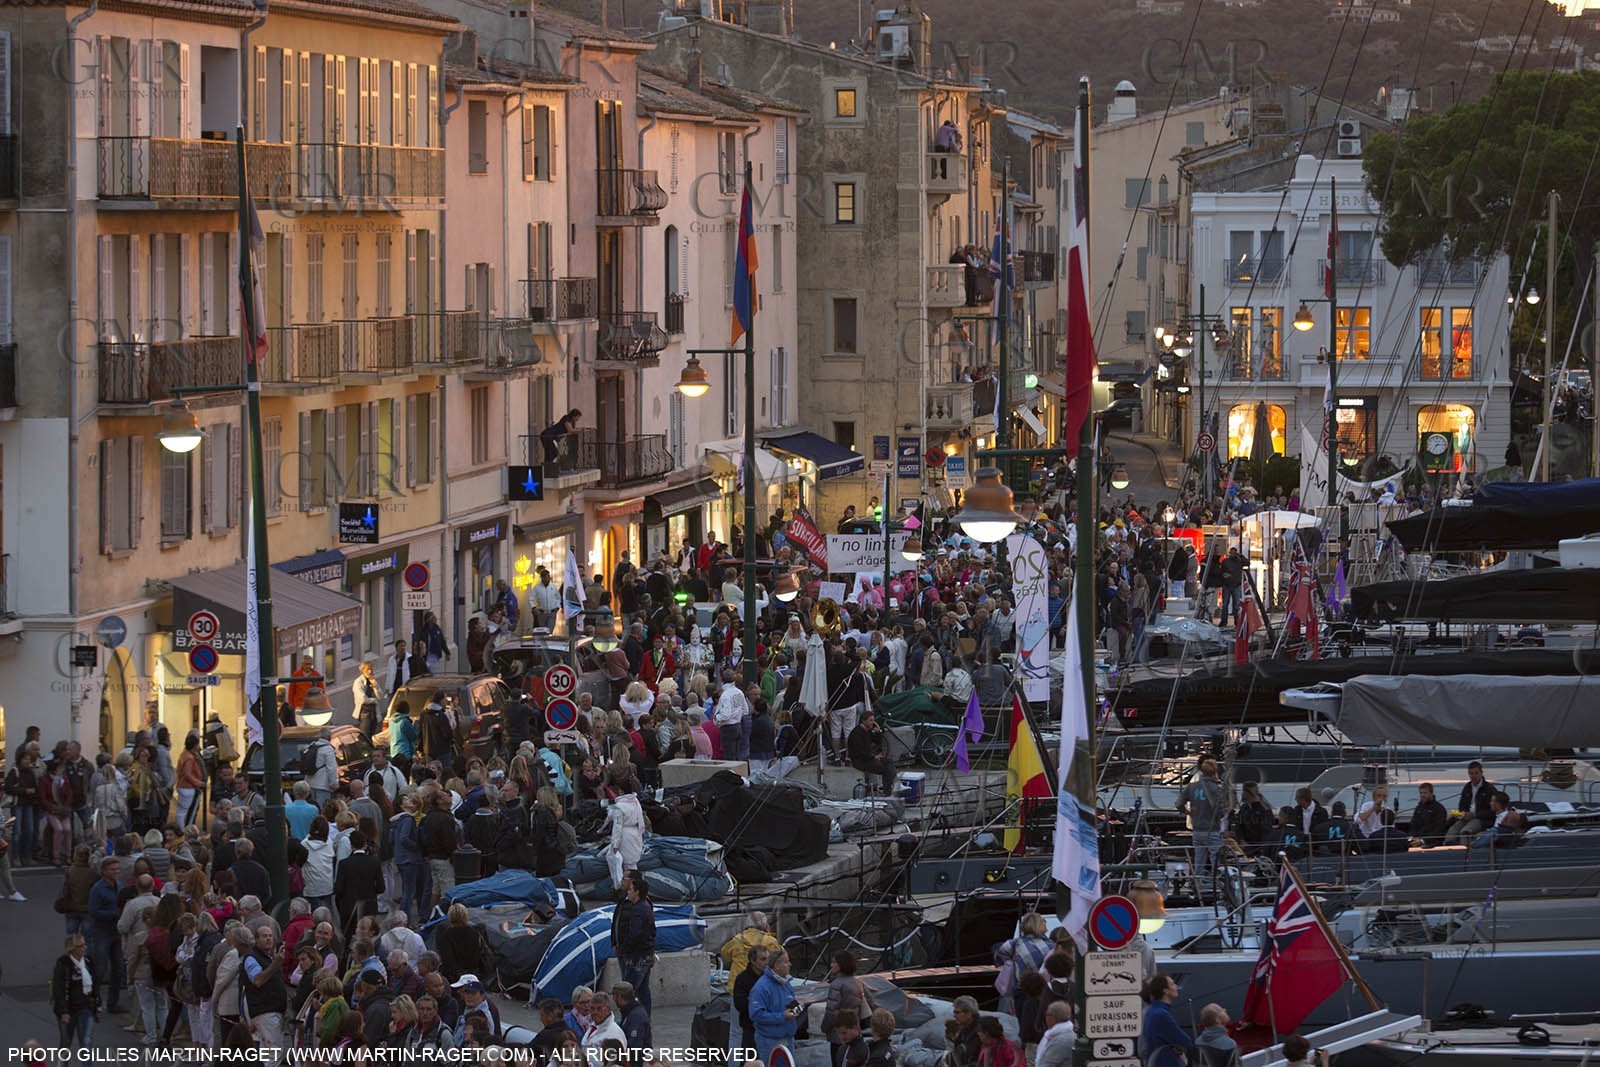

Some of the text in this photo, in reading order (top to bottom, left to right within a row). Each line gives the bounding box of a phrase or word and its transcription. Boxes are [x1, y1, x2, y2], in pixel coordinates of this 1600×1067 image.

[842, 540, 861, 552] no
[195, 620, 213, 633] 30
[297, 615, 345, 648] BARBARAC
[551, 675, 570, 688] 30
[1089, 953, 1138, 961] STATIONNEMENT
[1103, 1000, 1125, 1009] SAUF
[1089, 1011, 1138, 1021] LIVRAISONS
[1090, 1025, 1102, 1034] DE
[1124, 1023, 1137, 1032] 11H
